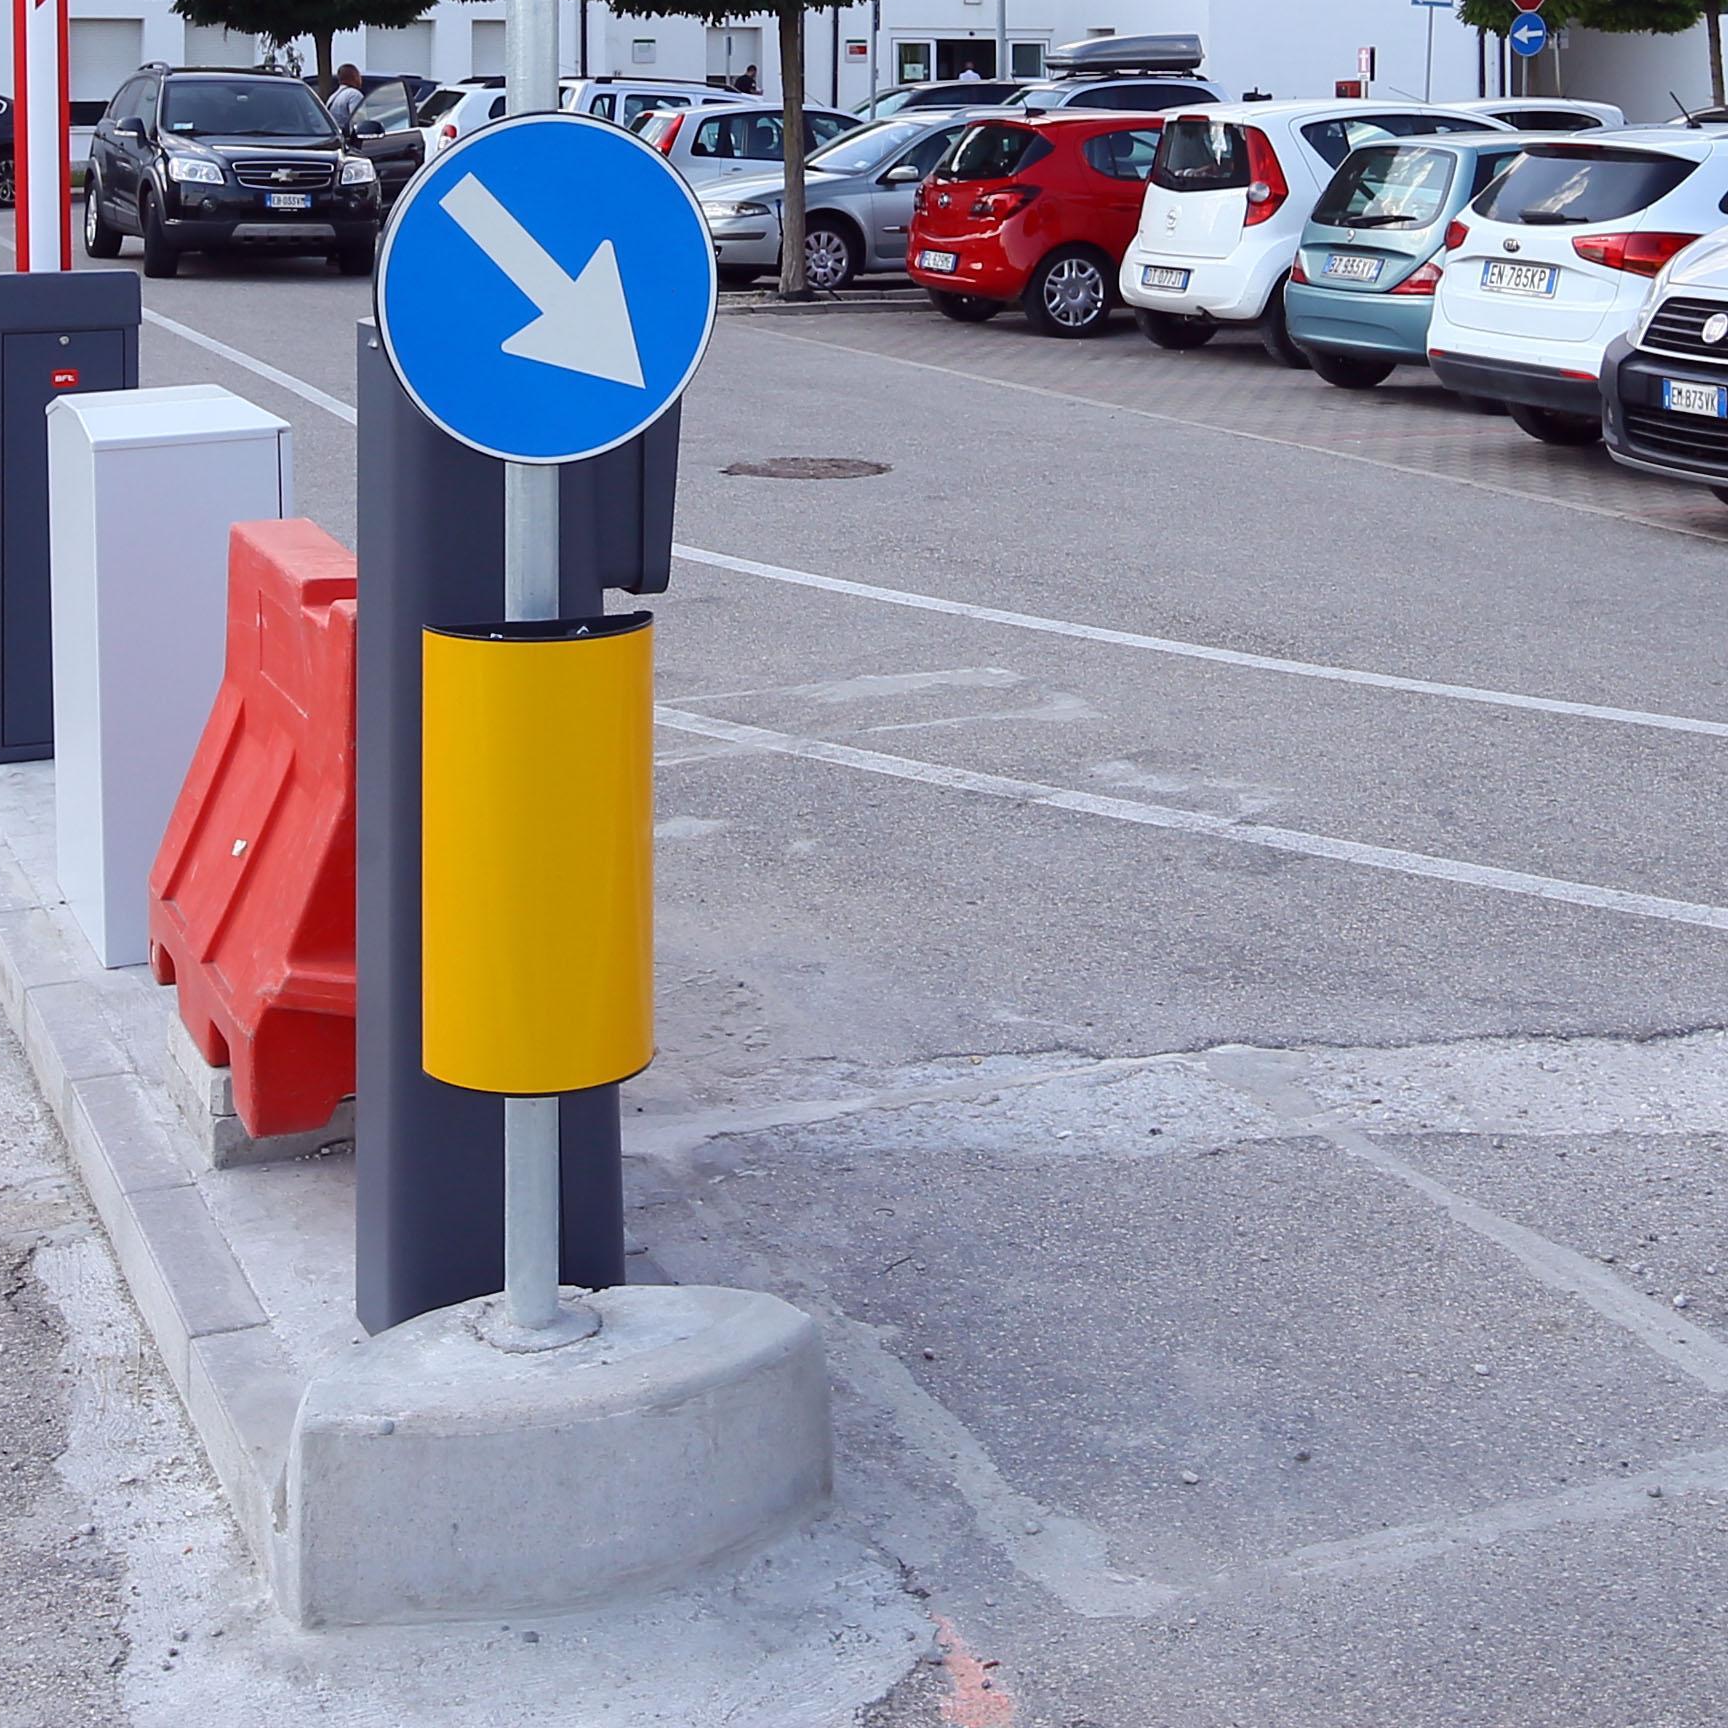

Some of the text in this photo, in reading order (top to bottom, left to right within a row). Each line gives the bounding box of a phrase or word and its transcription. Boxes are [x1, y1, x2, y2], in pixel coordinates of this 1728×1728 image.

[1489, 264, 1506, 285] EN
[1507, 266, 1547, 290] 785KP
[1672, 387, 1683, 406] EM
[1685, 388, 1717, 412] 873VK
